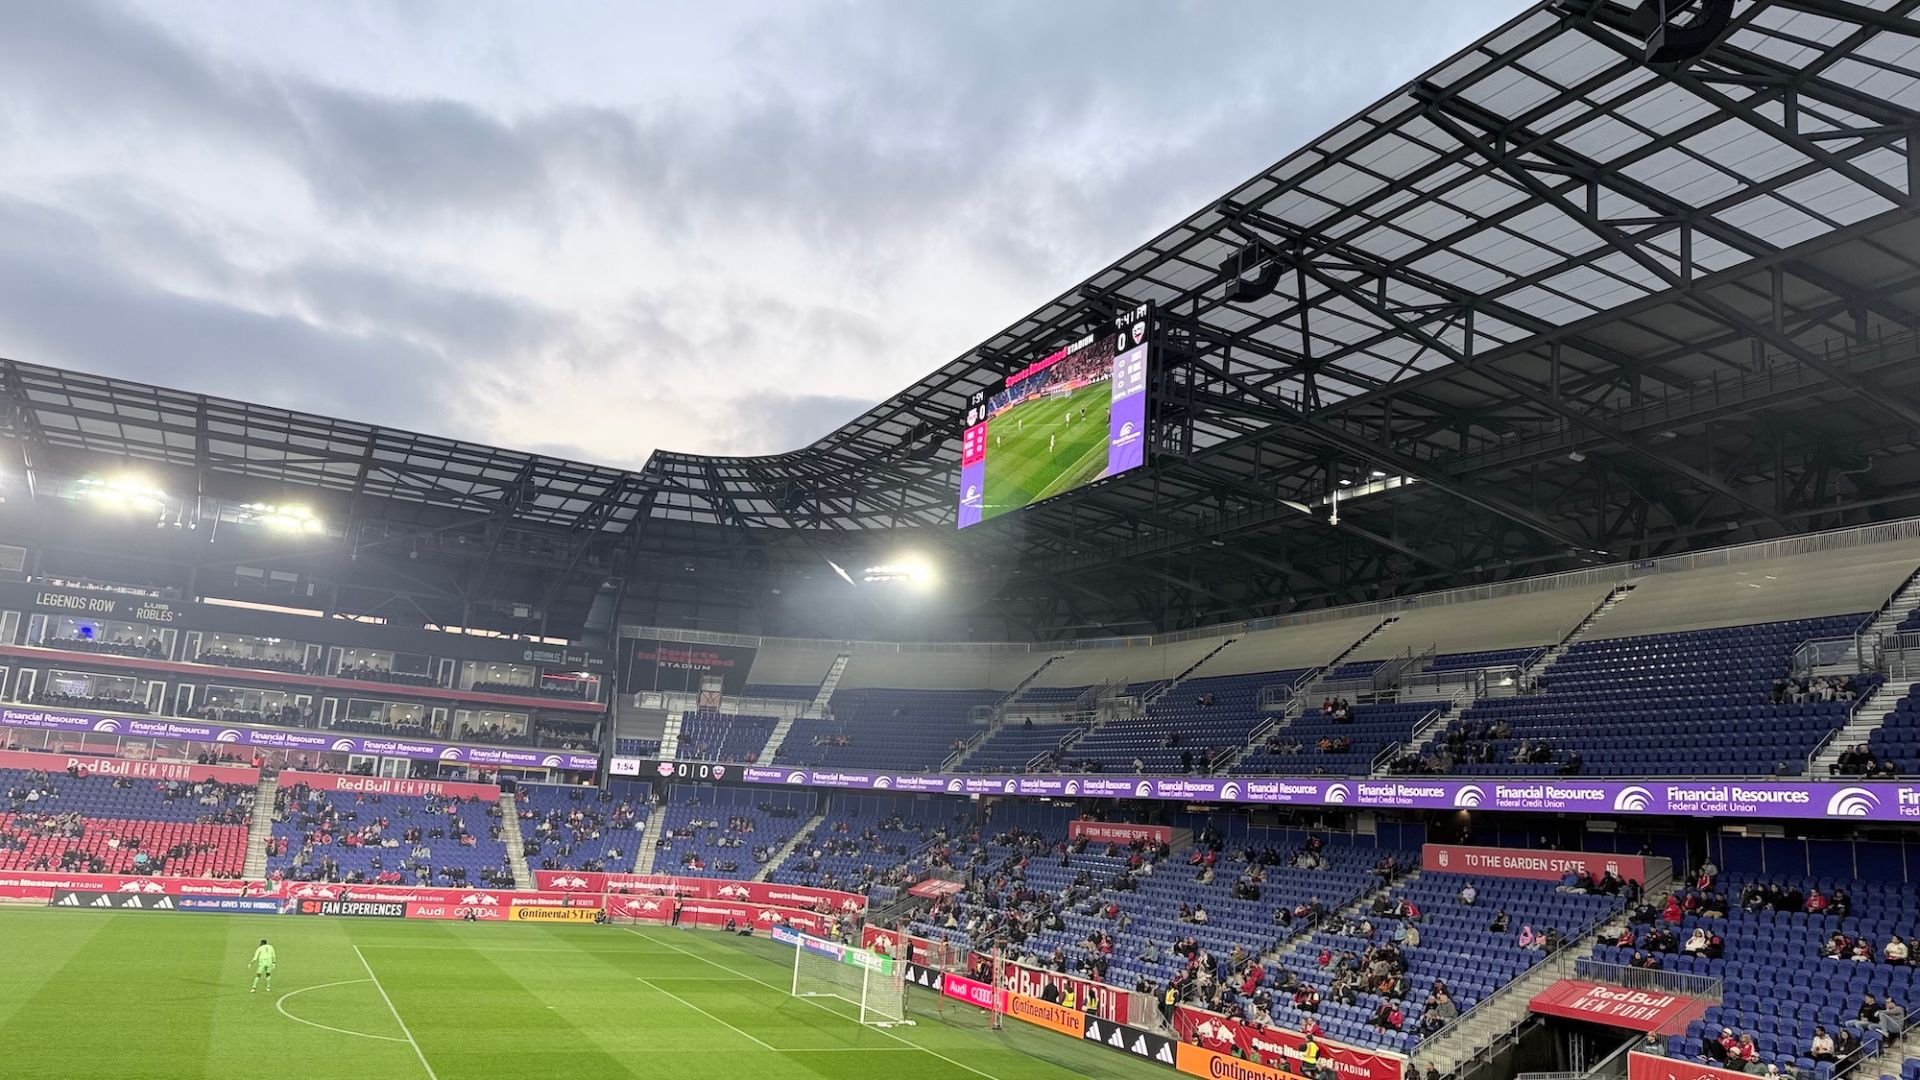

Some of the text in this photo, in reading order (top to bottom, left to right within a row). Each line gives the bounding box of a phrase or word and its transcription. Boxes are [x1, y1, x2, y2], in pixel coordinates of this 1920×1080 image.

[1116, 303, 1147, 329] 7:41 PM
[1068, 334, 1094, 355] STADIUM
[1117, 332, 1126, 350] 0
[980, 404, 986, 420] 0
[36, 592, 116, 613] LEGENDS ROW
[136, 608, 174, 622] ROBLES
[660, 662, 711, 671] STADIUM
[4, 710, 88, 724] Financial Resources
[130, 722, 210, 734] Financial Resources
[250, 732, 325, 744] Financial Resources
[364, 740, 434, 753] Financial Resources
[470, 749, 536, 761] Financial Resources
[100, 760, 130, 774] Bull
[134, 762, 158, 776] NEW
[161, 764, 190, 779] YORK
[616, 762, 634, 771] 1:54
[678, 764, 687, 778] 0
[700, 765, 709, 778] 0
[750, 768, 782, 778] Resources
[812, 772, 868, 782] Financial Resources
[896, 776, 944, 786] Financial Resources
[336, 778, 364, 790] Red
[365, 780, 390, 792] Bull
[394, 781, 414, 794] NEW
[1084, 780, 1132, 790] Financial Resources
[1158, 780, 1214, 792] Financial Resources
[1248, 782, 1317, 794] Financial Resources
[1358, 784, 1444, 798] Financial Resources
[1496, 785, 1605, 800] Financial Resources
[1666, 786, 1809, 804] Financial Resources
[1496, 798, 1566, 808] Federal Credit Union
[1668, 802, 1756, 812] Federal Credit Union
[1086, 828, 1100, 836] FROM
[1101, 828, 1111, 837] THE
[1112, 829, 1132, 838] EMPIRE
[1465, 854, 1586, 874] TO THE GARDEN STATE
[20, 878, 70, 888] Illustrated
[608, 880, 634, 888] Sports
[348, 892, 375, 900] Sports
[376, 892, 418, 902] Illustrated
[768, 891, 791, 899] Sports
[511, 898, 537, 906] Sports
[322, 902, 340, 914] FAN
[342, 902, 402, 916] EXPERIENCES
[416, 906, 445, 916] Audi
[518, 908, 570, 920] Continental
[950, 981, 966, 995] Audi
[1588, 986, 1676, 1008] Red Bull
[1012, 996, 1080, 1030] Continental Tire
[1570, 996, 1660, 1020] NEW YORK
[1252, 1038, 1371, 1078] Sports STADIUM
